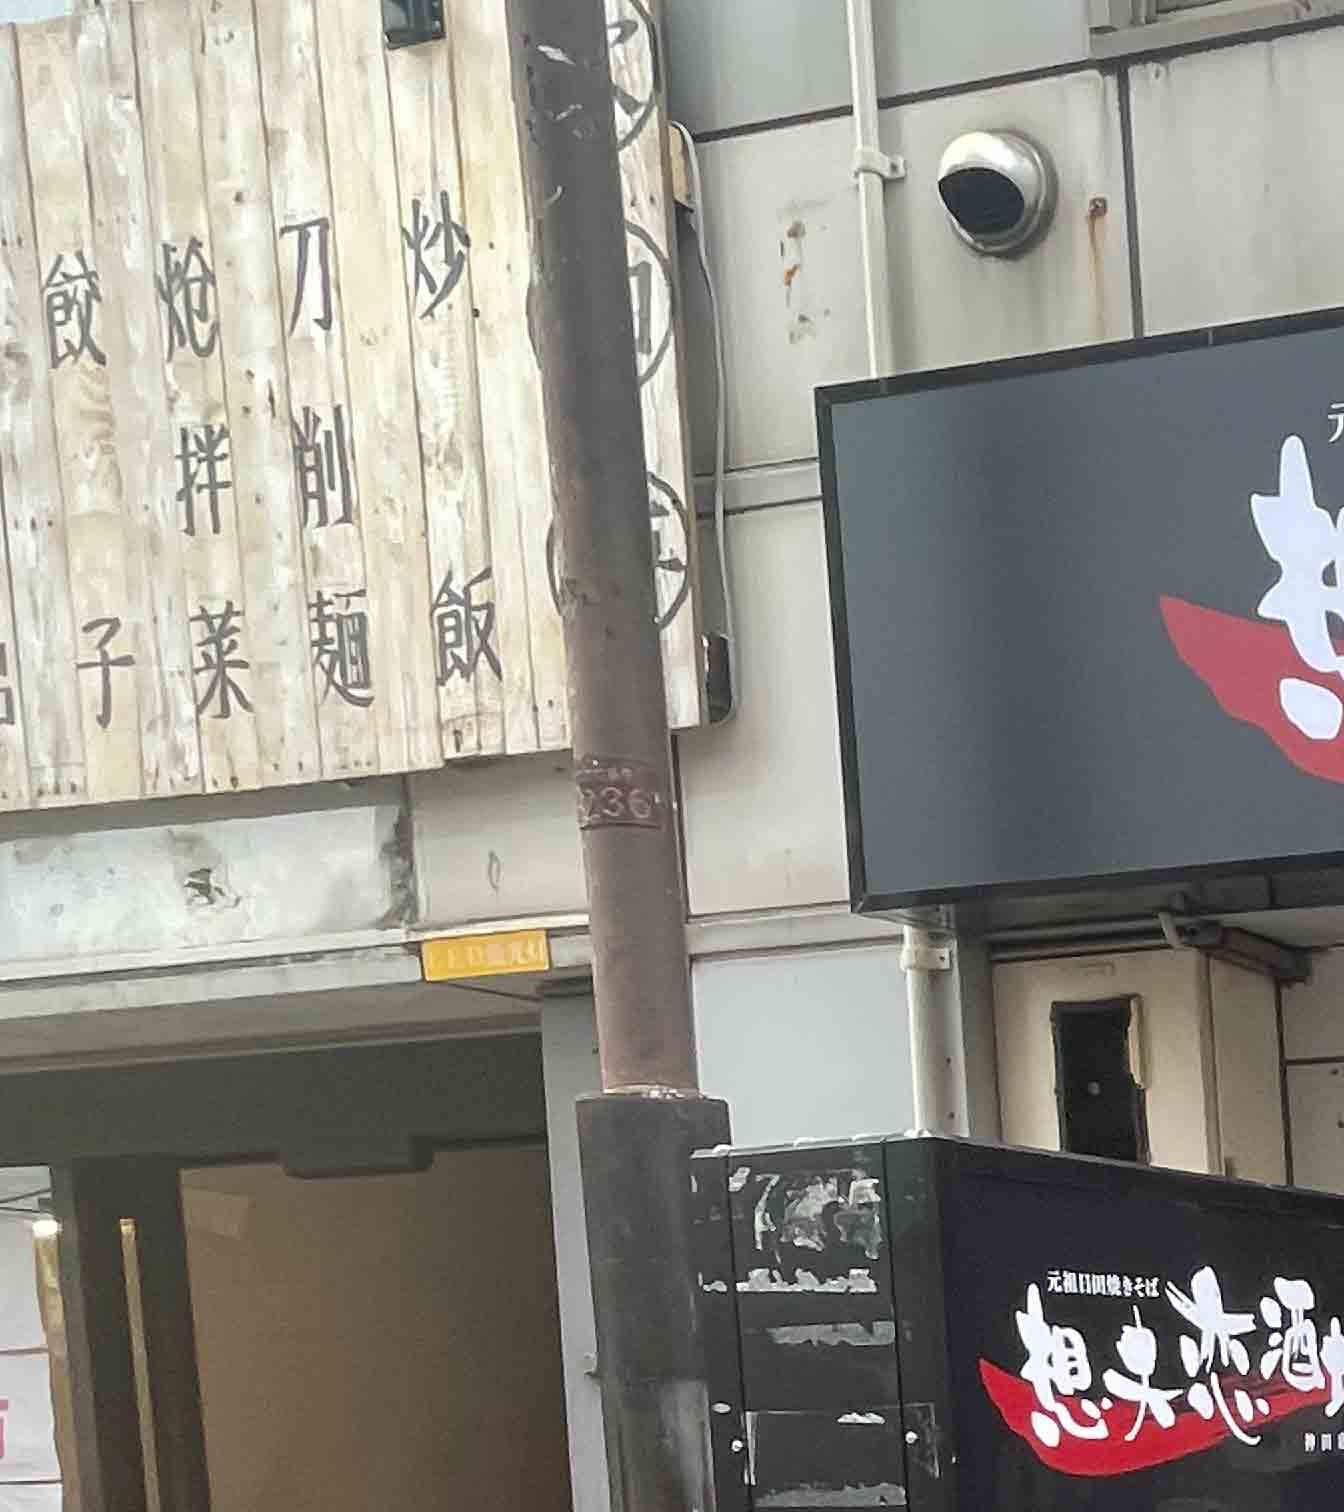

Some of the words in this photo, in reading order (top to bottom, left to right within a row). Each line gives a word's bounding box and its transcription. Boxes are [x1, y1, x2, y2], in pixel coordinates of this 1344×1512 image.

[401, 190, 503, 687] 炒飯
[1046, 1270, 1160, 1299] 元祖日田焼きそば
